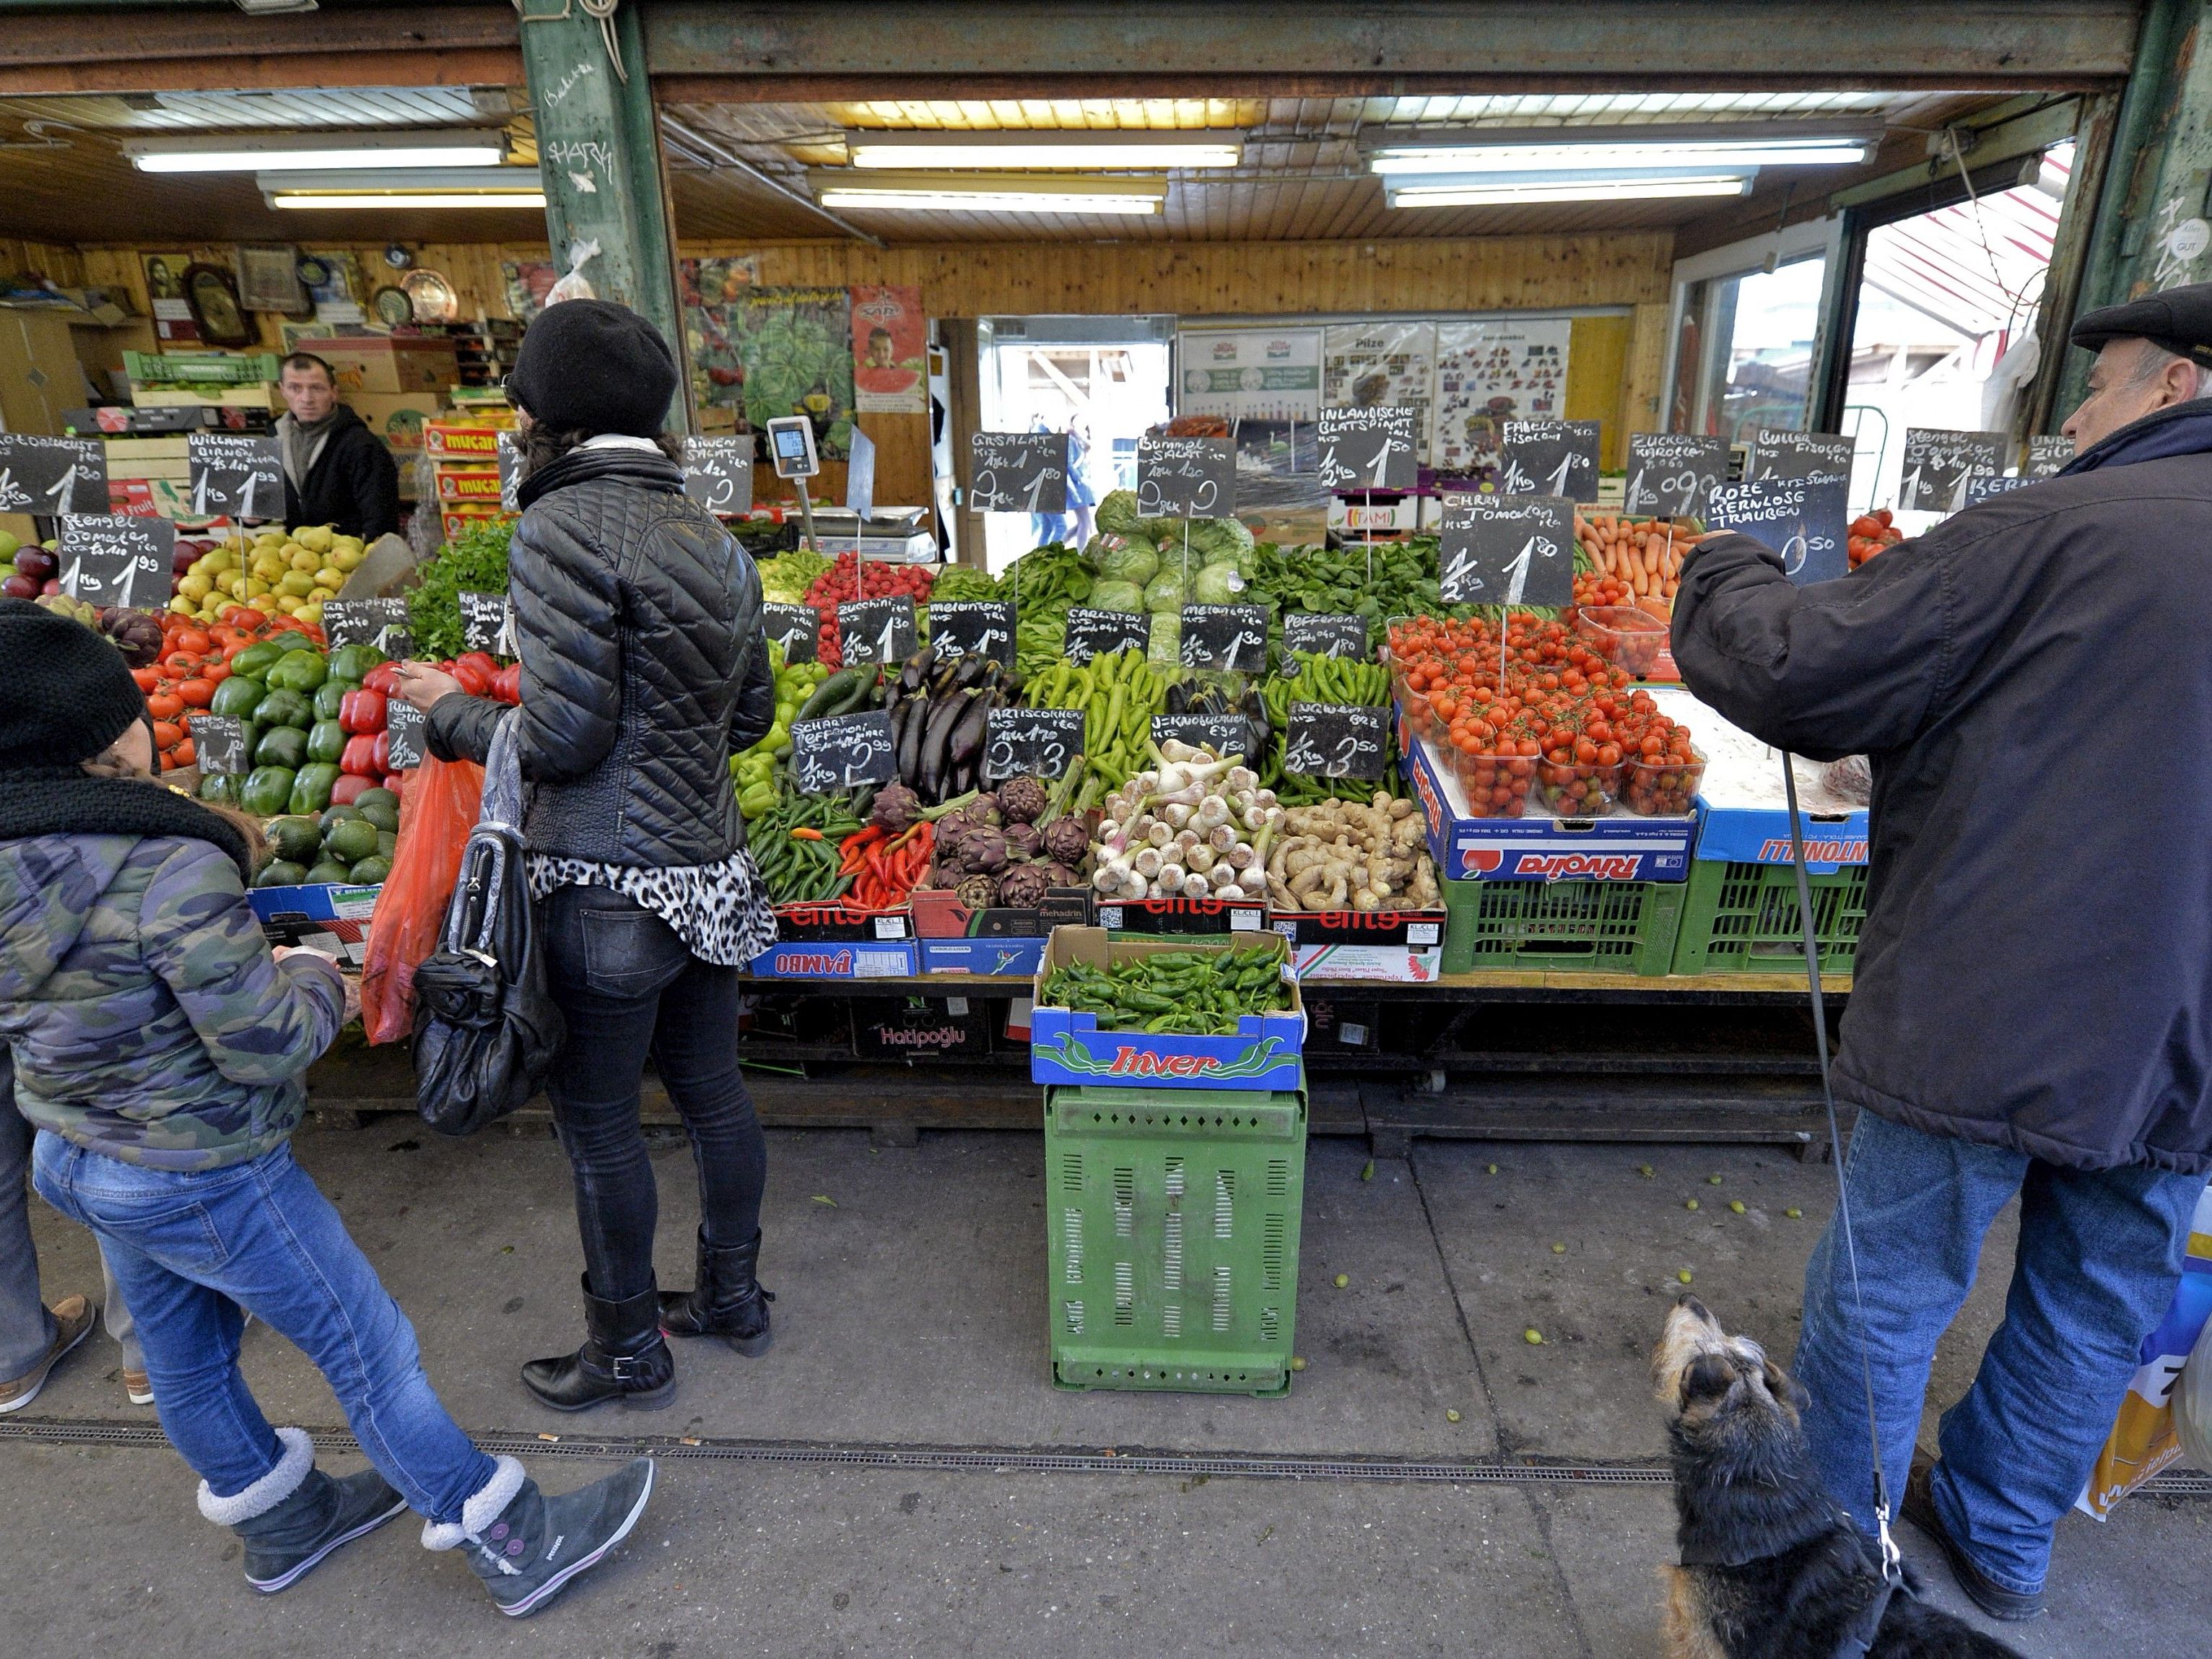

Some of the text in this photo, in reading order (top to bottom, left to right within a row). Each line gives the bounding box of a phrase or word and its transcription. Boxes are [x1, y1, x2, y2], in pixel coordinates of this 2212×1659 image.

[1355, 338, 1385, 349] Pilze
[1710, 507, 1801, 529] TRAUBEN
[1514, 853, 1644, 881] Rivoira
[775, 949, 854, 975] PAMBO
[1107, 1045, 1223, 1078] Inver
